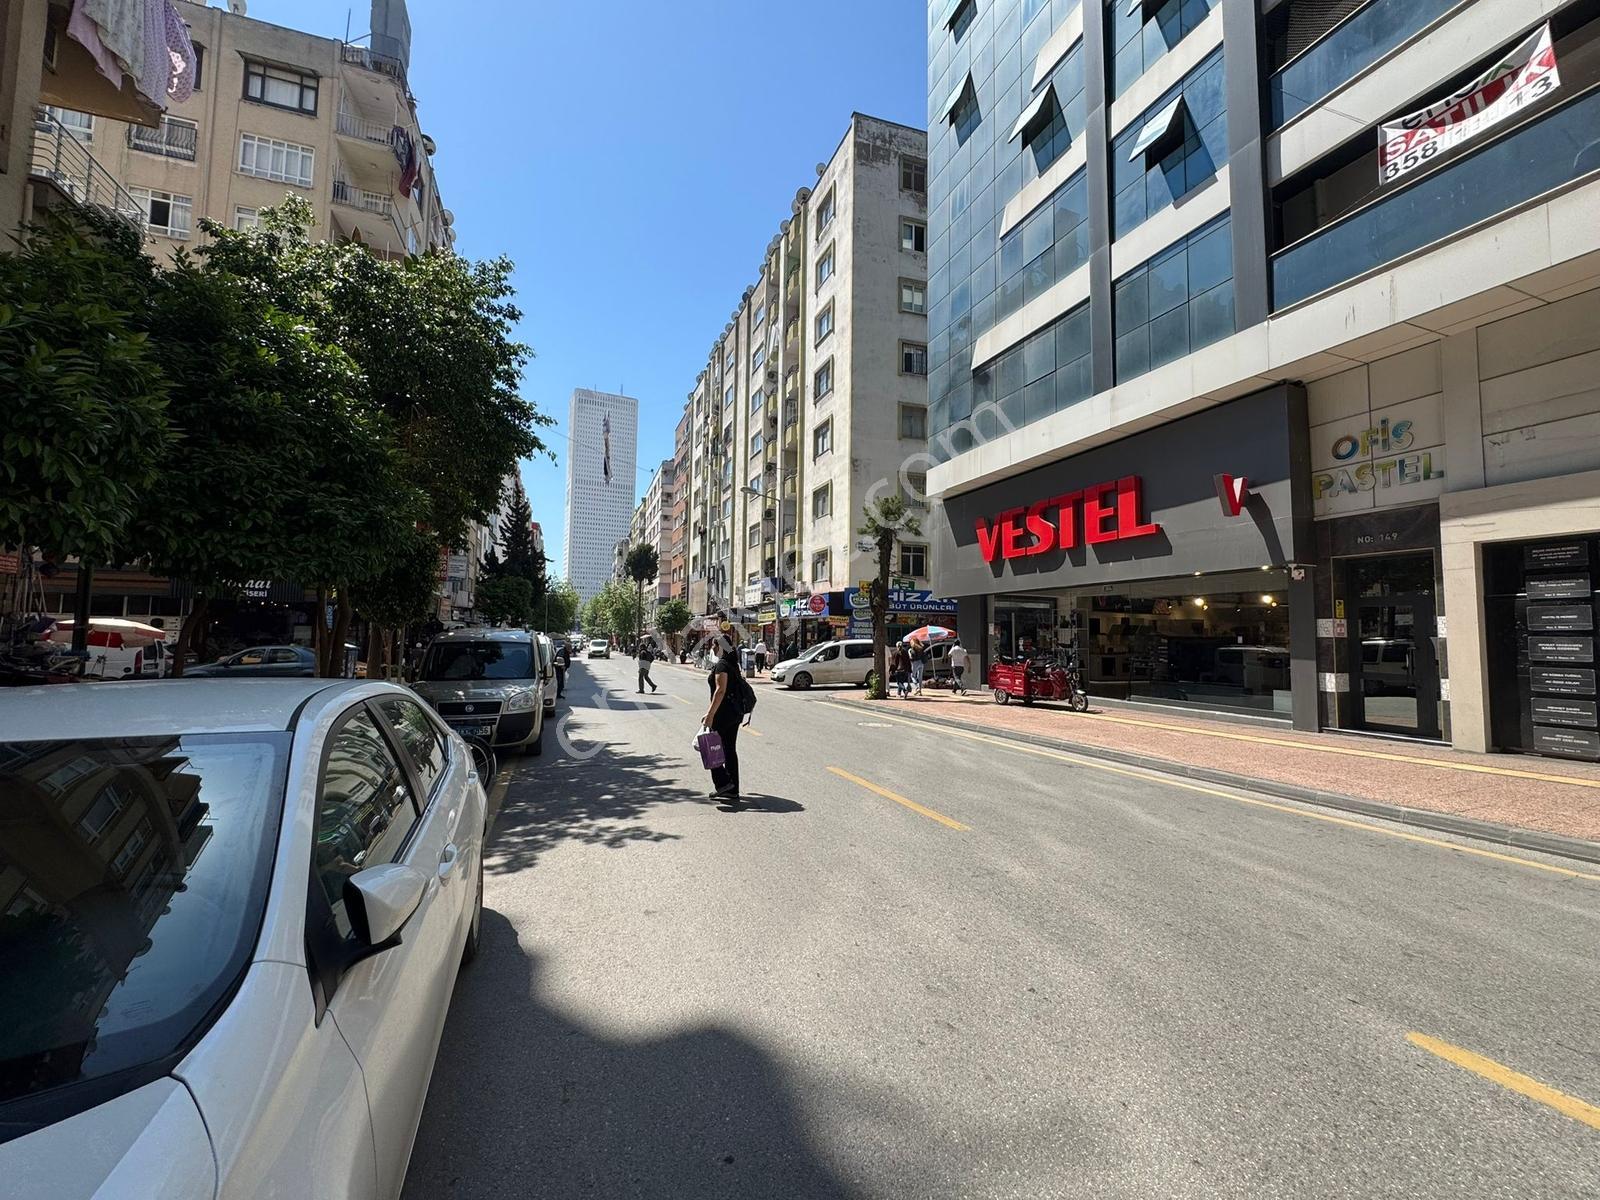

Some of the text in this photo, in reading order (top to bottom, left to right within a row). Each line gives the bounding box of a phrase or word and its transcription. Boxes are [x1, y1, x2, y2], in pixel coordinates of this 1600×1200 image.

[1384, 140, 1438, 181] 358
[1313, 452, 1444, 500] PASTEL
[975, 475, 1161, 563] VESTEL
